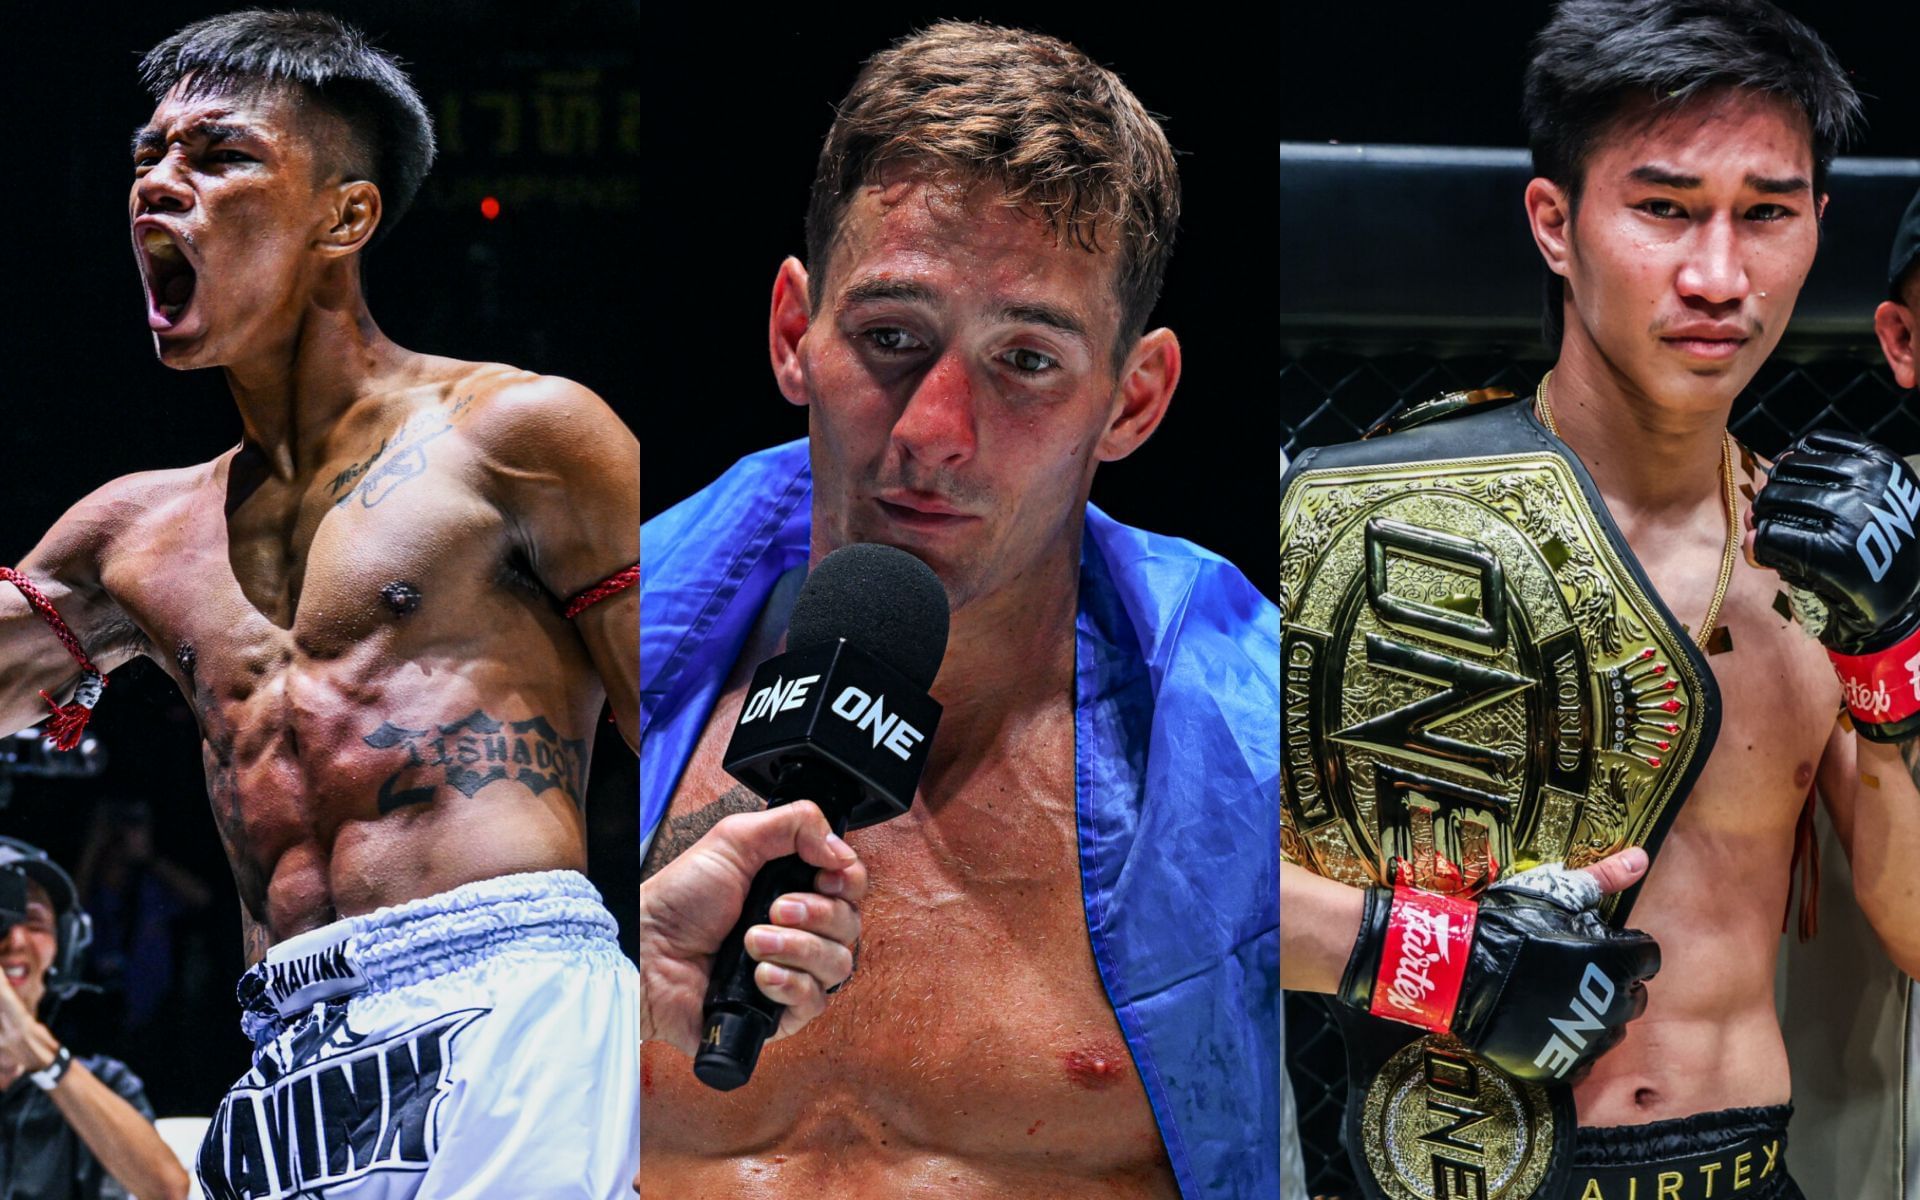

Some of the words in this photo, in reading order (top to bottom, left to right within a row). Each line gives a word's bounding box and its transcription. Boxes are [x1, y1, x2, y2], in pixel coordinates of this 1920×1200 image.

[1857, 461, 1920, 582] ONE
[740, 674, 821, 725] ONE
[831, 686, 925, 761] ONE
[1286, 641, 1327, 818] CHAMPION
[1328, 516, 1538, 880] ONE
[1553, 649, 1582, 772] WORLD
[271, 939, 355, 1002] MAVINK
[1388, 902, 1449, 1014] Fairtex
[1533, 962, 1615, 1079] ONE
[1416, 1049, 1497, 1200] ONE
